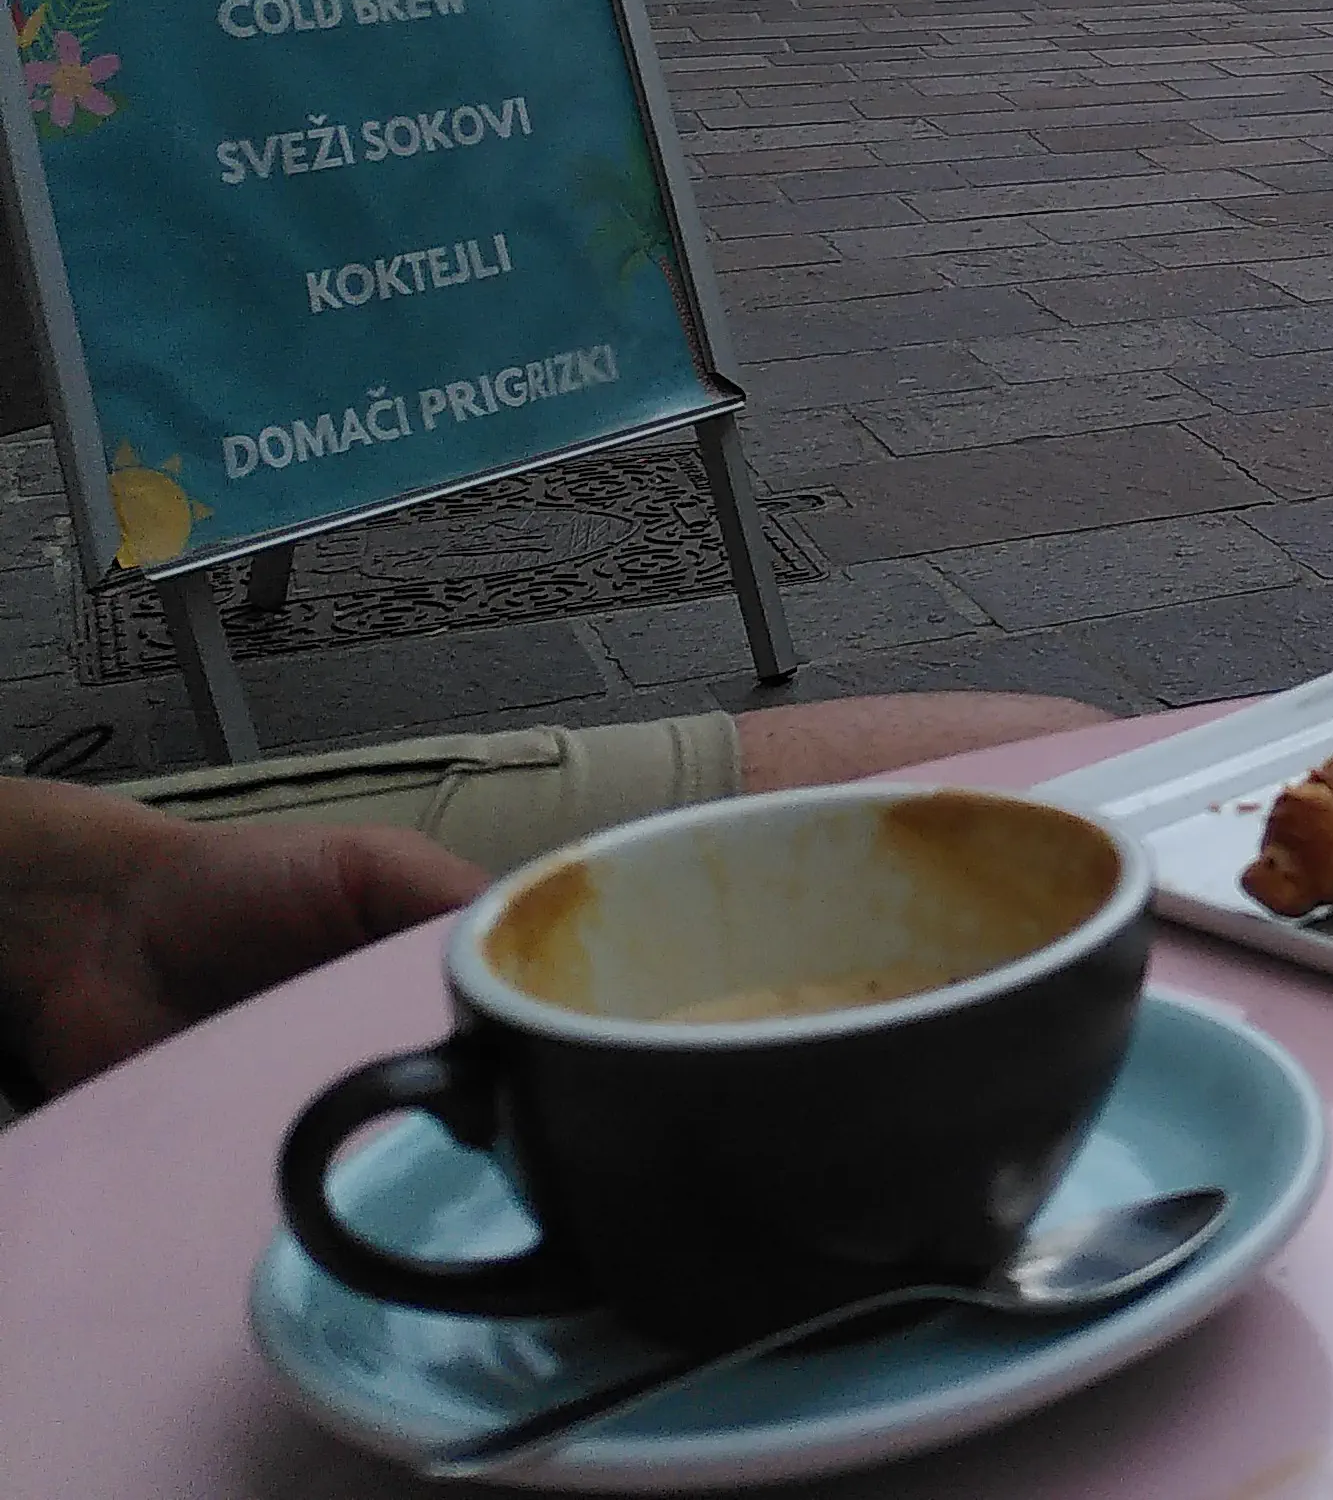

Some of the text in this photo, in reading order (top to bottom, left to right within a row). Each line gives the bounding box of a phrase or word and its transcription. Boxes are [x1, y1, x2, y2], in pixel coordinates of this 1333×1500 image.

[215, 96, 535, 186] SVEŽI SOKOVI
[305, 234, 514, 314] KOKTEJLI
[223, 344, 620, 480] DOMAČI PRIGRIZKI
